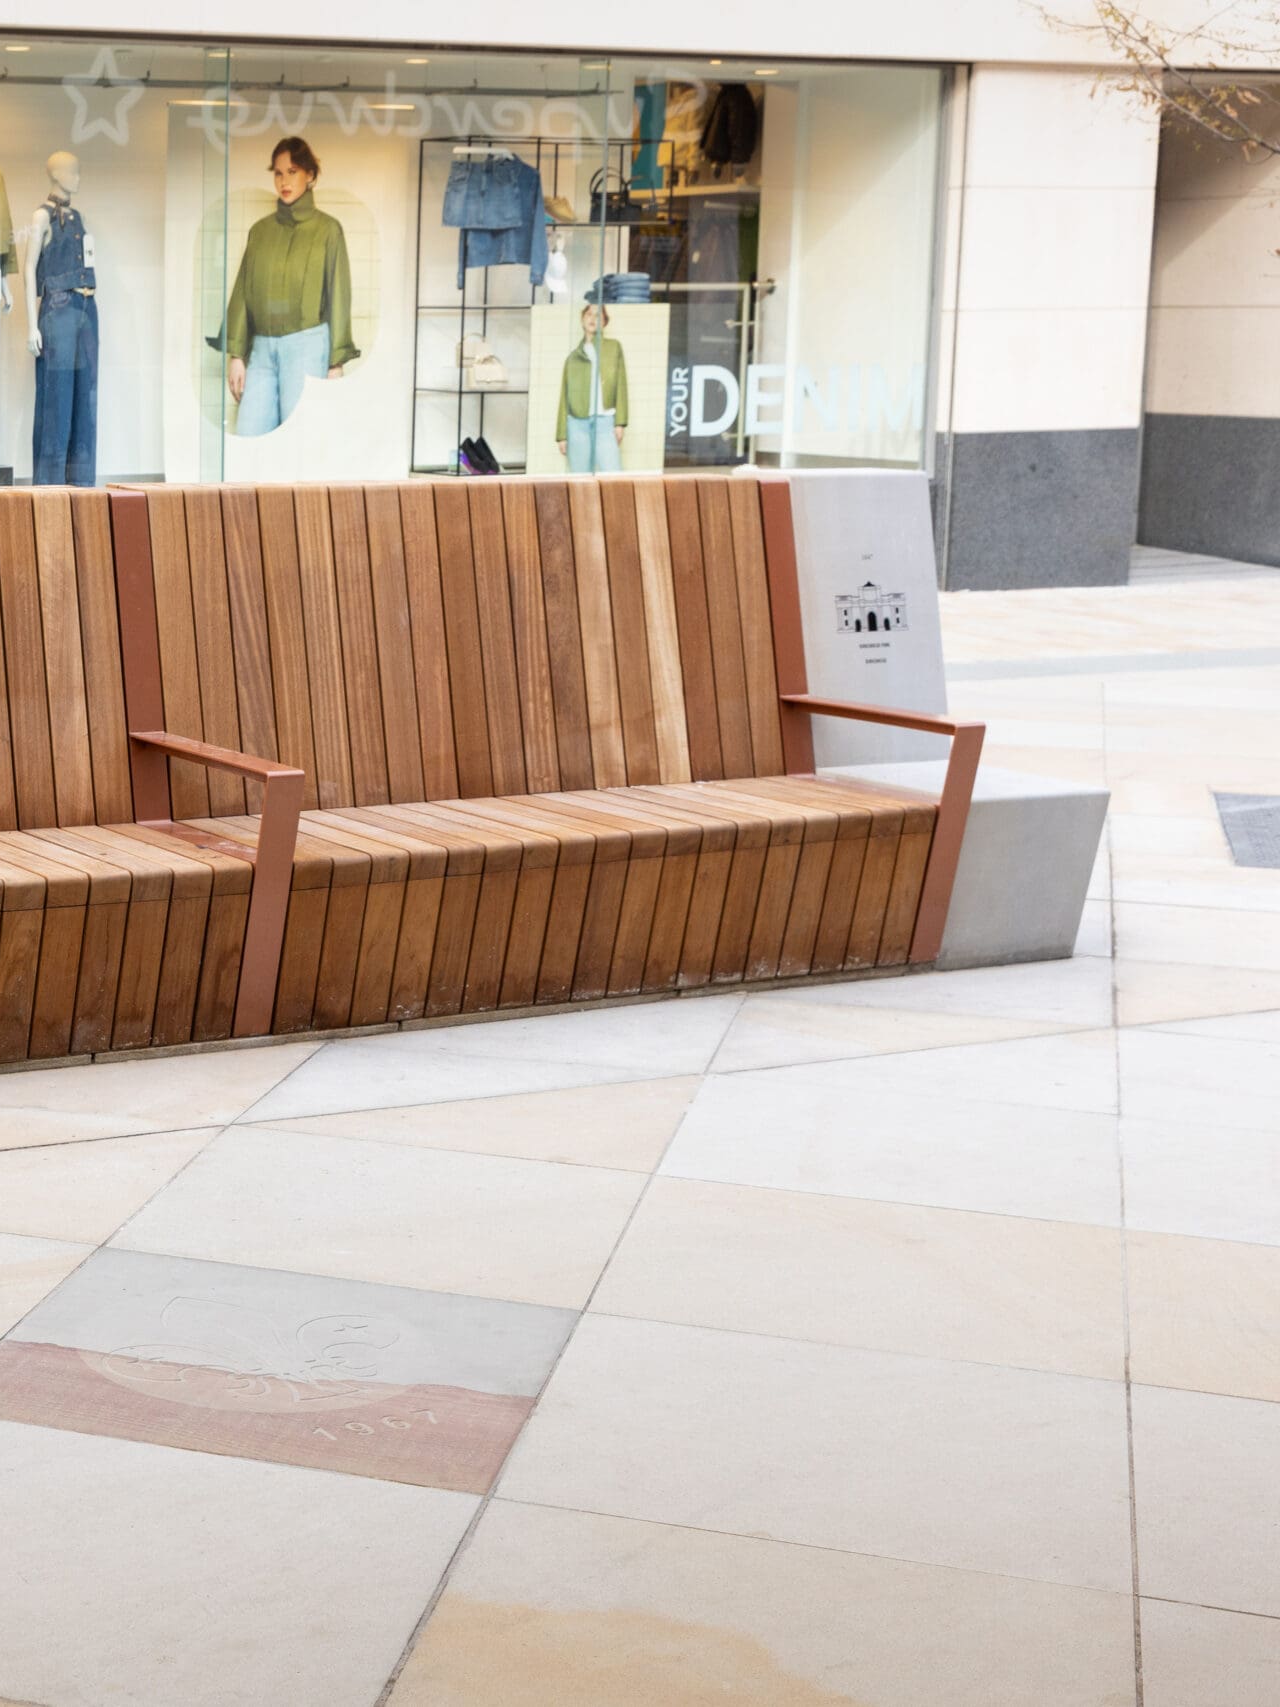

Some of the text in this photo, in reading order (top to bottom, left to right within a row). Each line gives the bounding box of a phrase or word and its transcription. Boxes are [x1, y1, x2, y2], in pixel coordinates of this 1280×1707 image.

[669, 366, 689, 437] YOUR
[689, 363, 924, 438] DENIM
[312, 1408, 438, 1441] 1967
